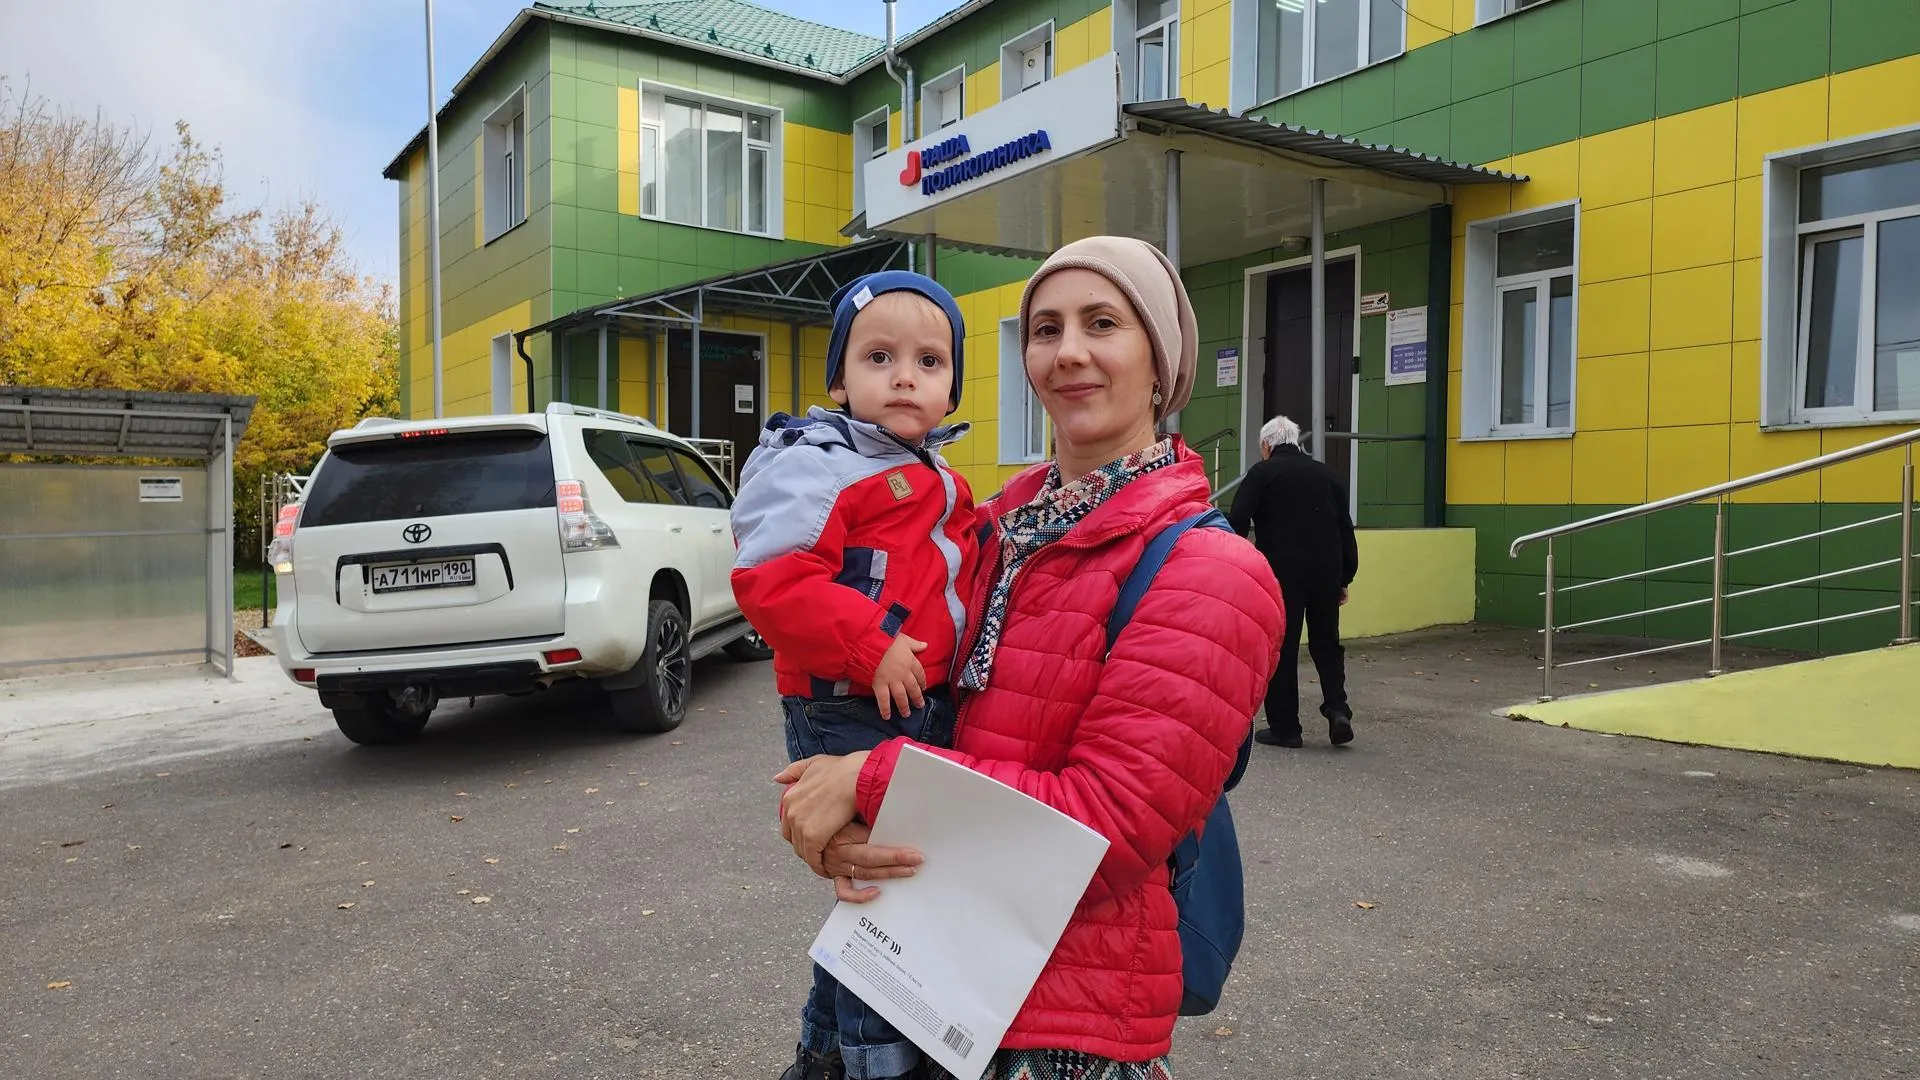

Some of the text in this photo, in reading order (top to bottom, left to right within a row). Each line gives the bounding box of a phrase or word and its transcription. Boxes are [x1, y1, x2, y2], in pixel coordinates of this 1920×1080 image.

[921, 134, 971, 169] НАША
[922, 130, 1051, 196] ПОЛИКЛИНИКА
[444, 562, 467, 576] 190
[858, 917, 891, 944] STAFF
